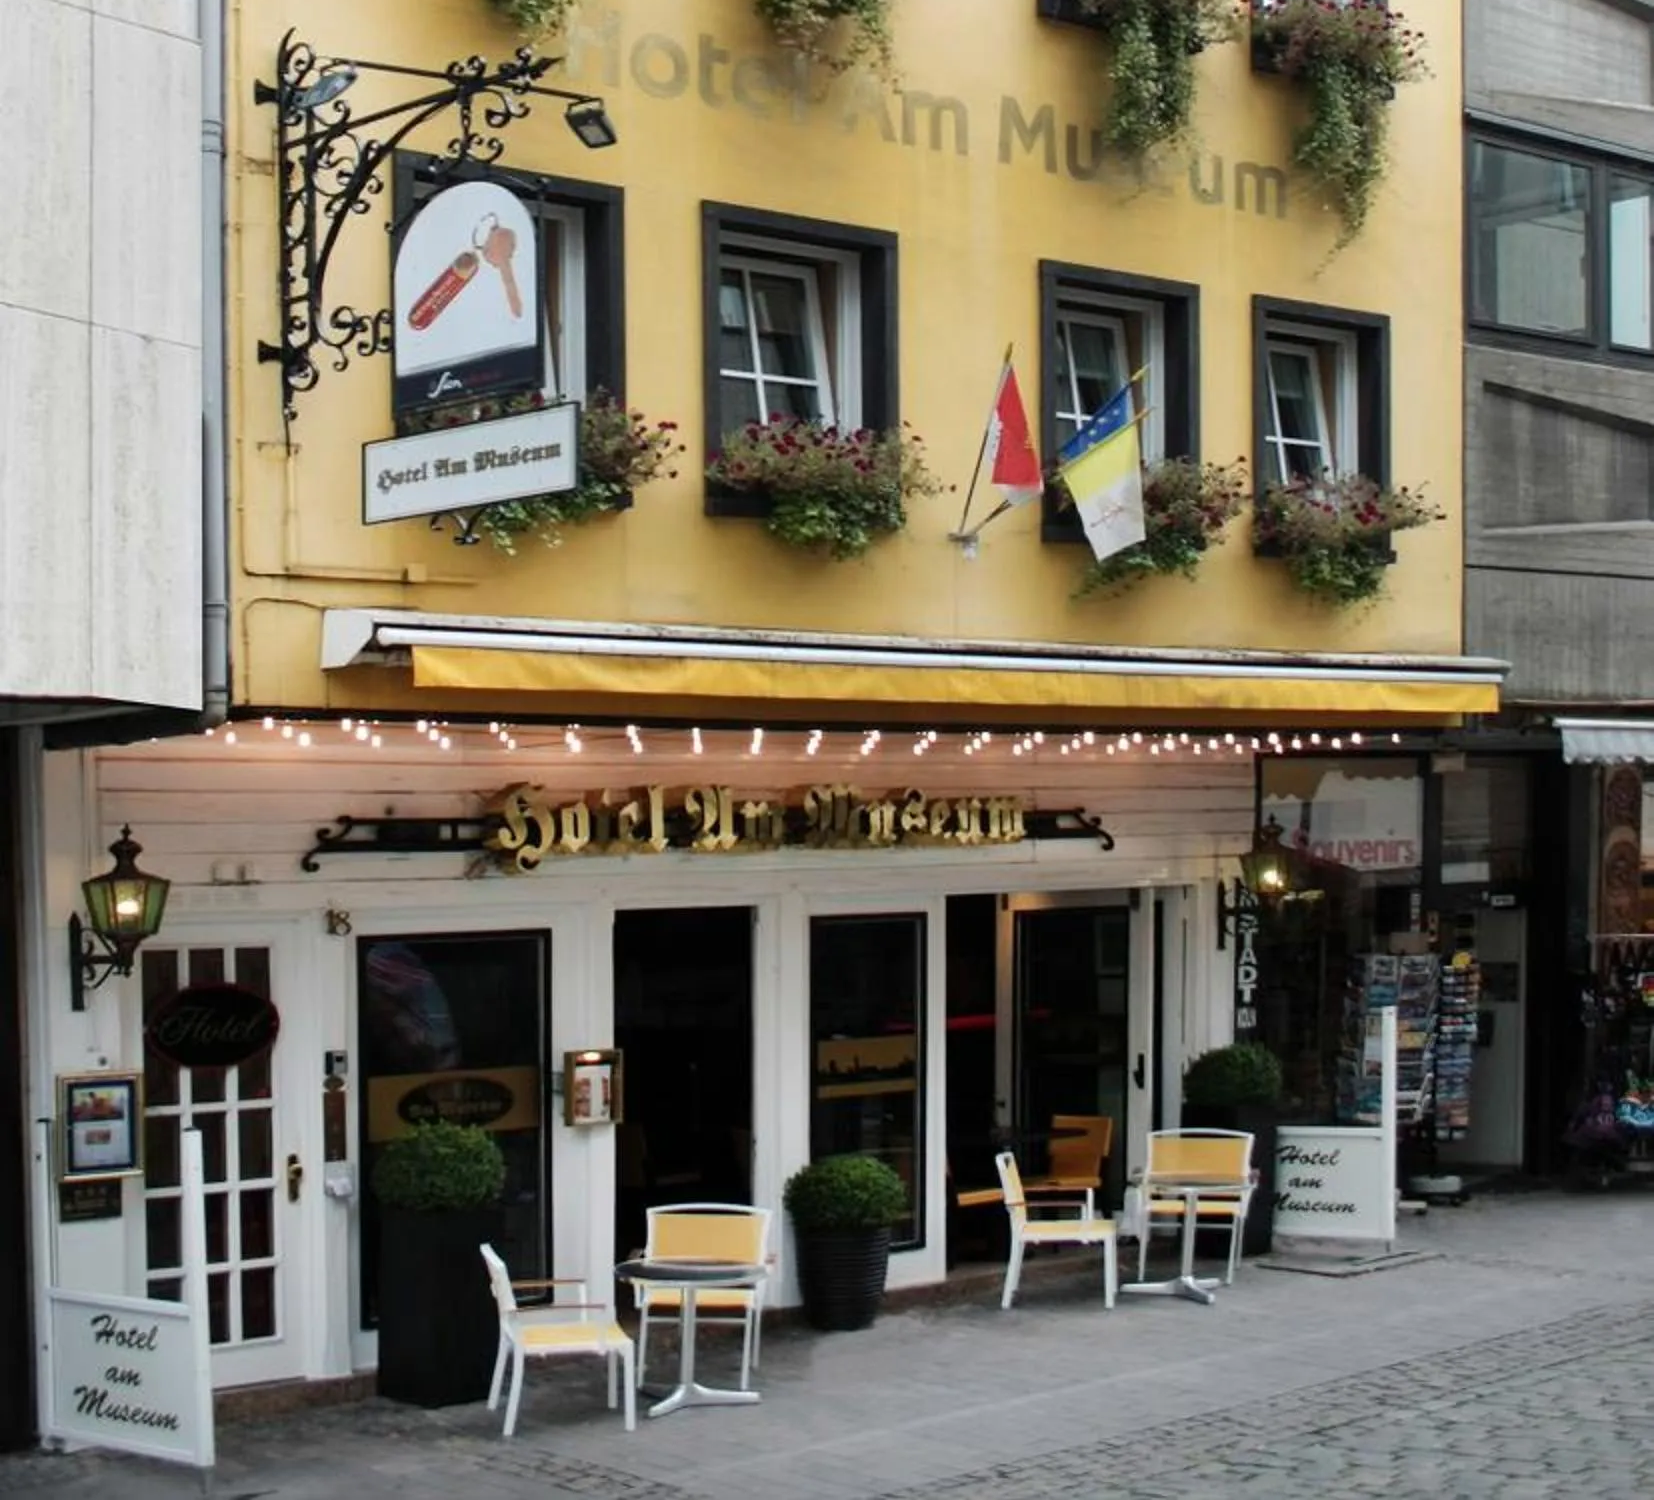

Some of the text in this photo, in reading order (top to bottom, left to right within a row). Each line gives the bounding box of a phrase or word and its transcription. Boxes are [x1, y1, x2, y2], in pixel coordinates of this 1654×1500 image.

[845, 75, 970, 156] Am
[999, 95, 1287, 219] Muum
[376, 442, 562, 495] Hotel Am Museum
[496, 778, 1027, 874] Hotel Am Museum
[1291, 823, 1418, 866] Souvenirs
[324, 907, 353, 937] 18
[157, 1004, 268, 1048] Hotel
[1274, 1144, 1341, 1167] Hotel
[1287, 1176, 1325, 1189] am
[90, 1313, 159, 1352] Hotel
[104, 1365, 142, 1387] am
[72, 1383, 181, 1432] Museum
